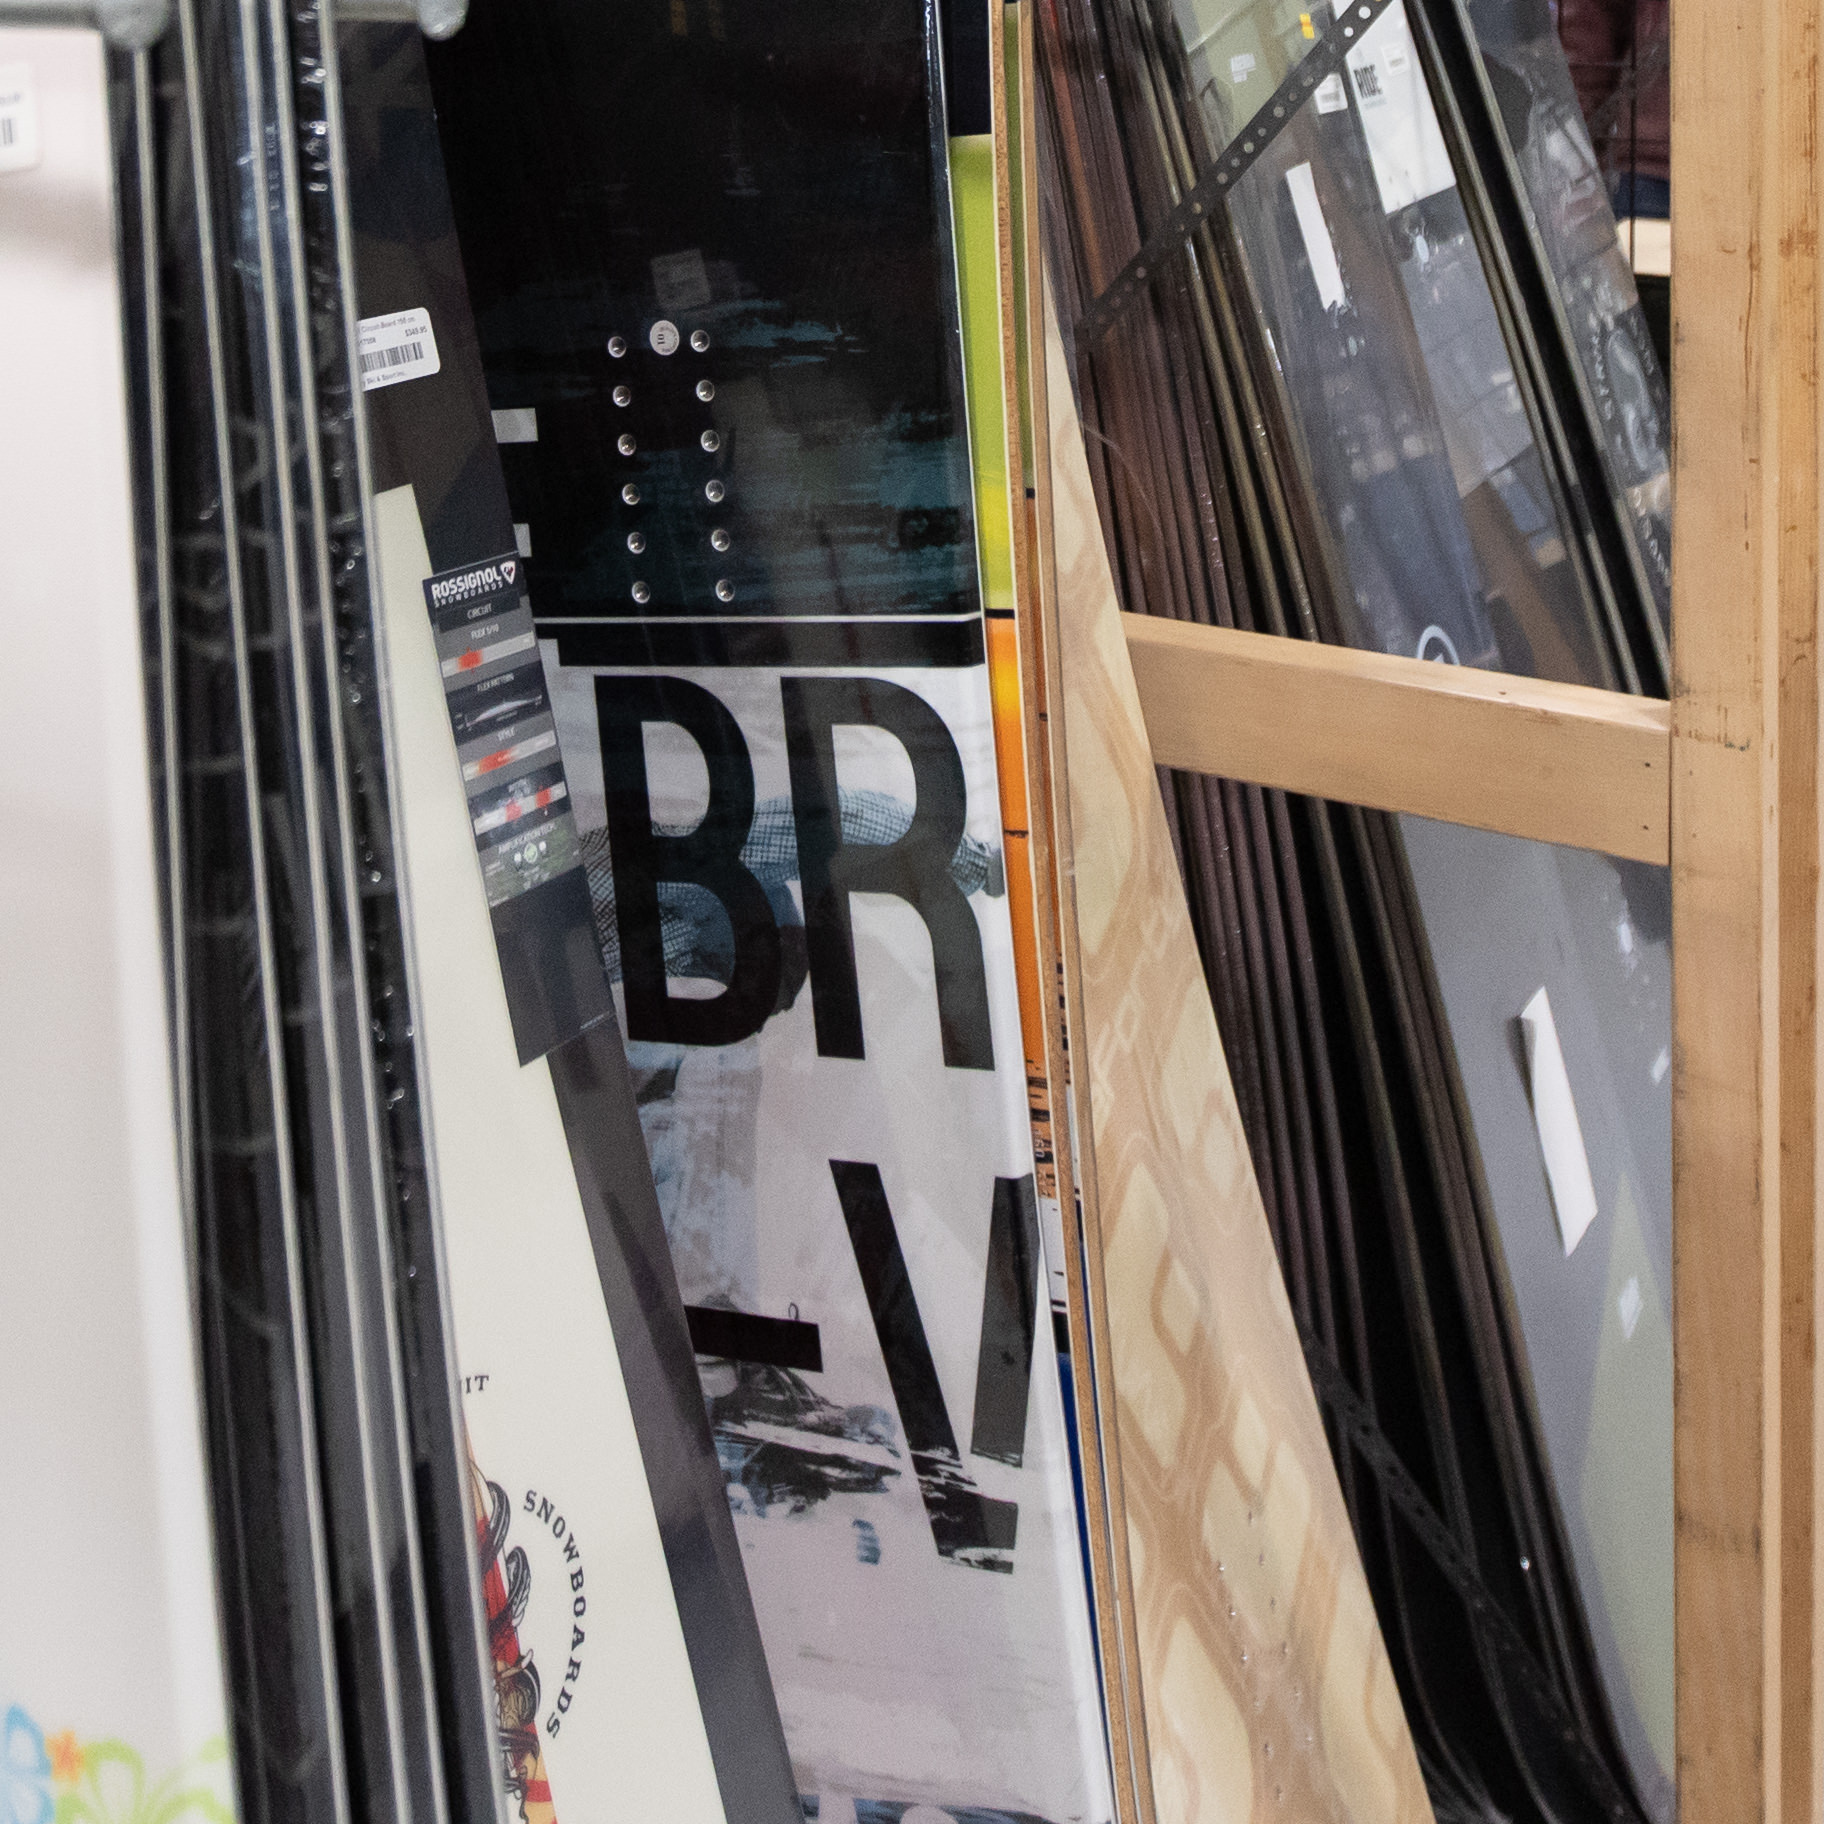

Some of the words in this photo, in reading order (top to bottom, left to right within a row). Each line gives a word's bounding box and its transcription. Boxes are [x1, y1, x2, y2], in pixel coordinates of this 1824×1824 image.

[431, 566, 502, 601] ROSSIGNOL
[434, 581, 503, 608] SNOWBOARDS
[462, 1374, 490, 1395] IT
[523, 1489, 587, 1740] SNOWBOARDS
